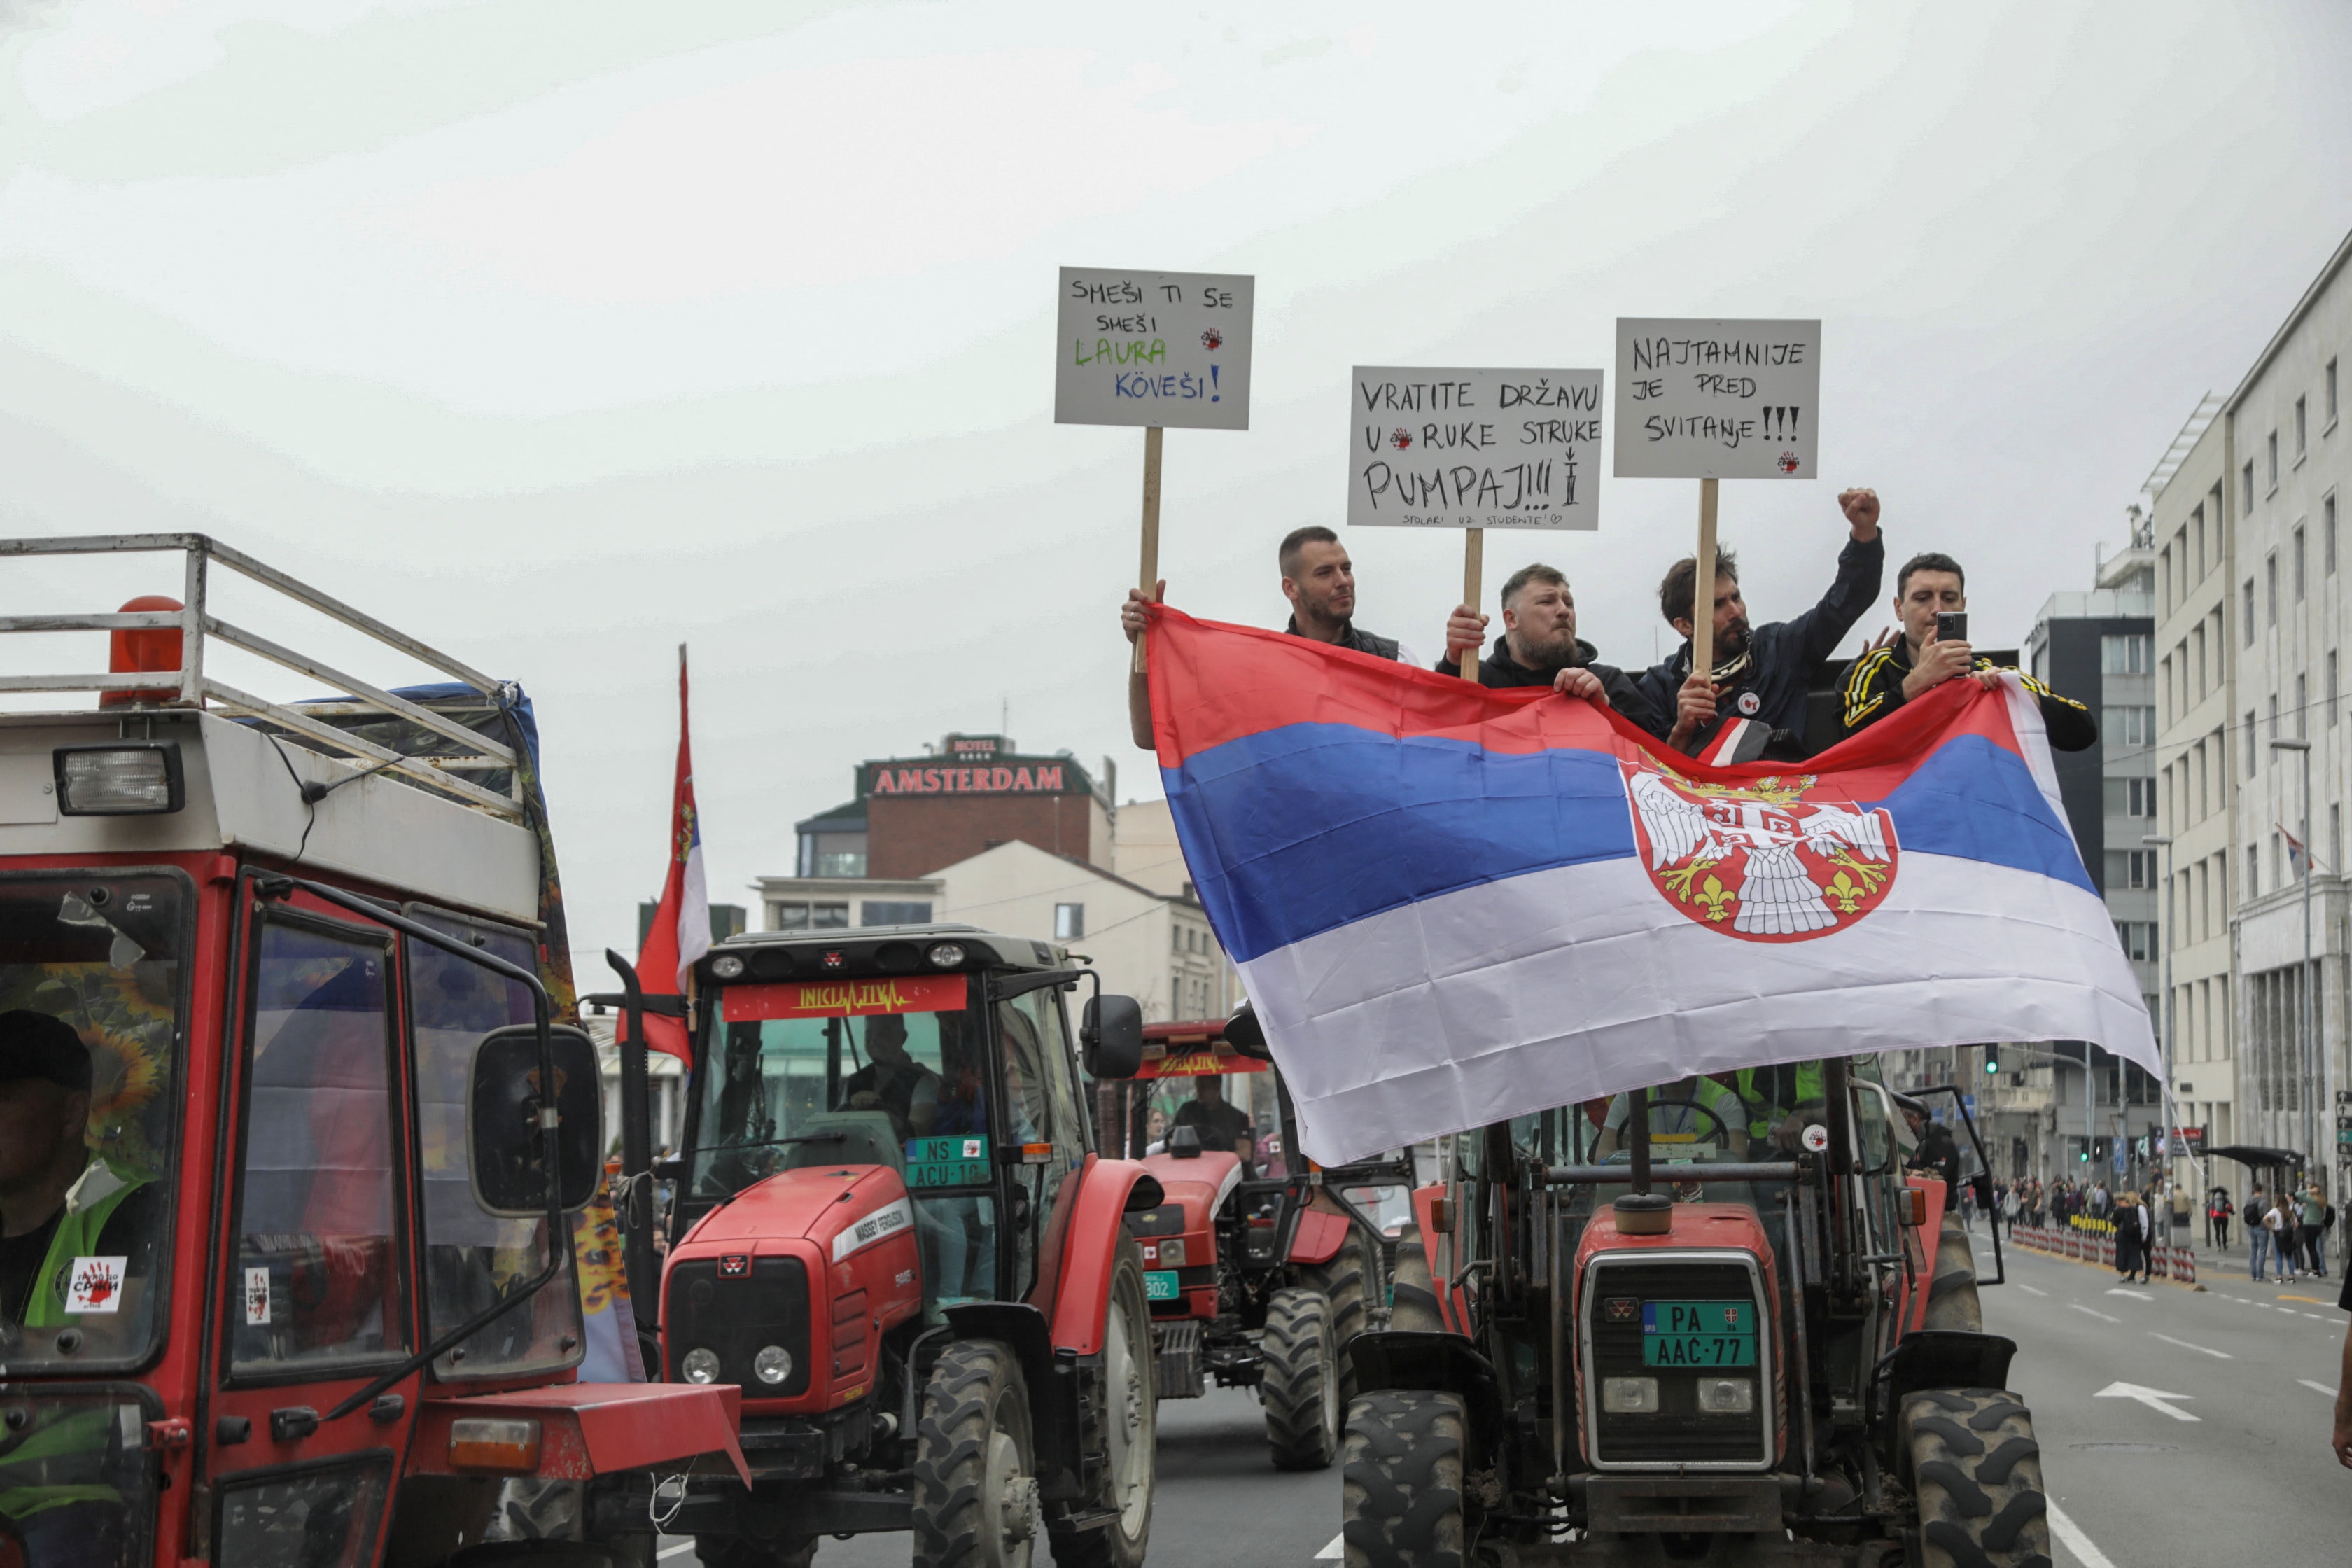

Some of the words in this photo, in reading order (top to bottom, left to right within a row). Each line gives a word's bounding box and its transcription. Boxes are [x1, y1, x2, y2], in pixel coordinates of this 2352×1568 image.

[1071, 280, 1142, 304] SMEŠI
[1159, 285, 1182, 303] TI
[1203, 288, 1233, 309] SE
[1096, 312, 1156, 332] SMEŠI
[1075, 337, 1166, 366] LAURA
[1633, 337, 1806, 372] NAJTAMNIJE
[1361, 382, 1475, 413] VRATITE
[1499, 378, 1599, 412] DRŽAVU
[1631, 379, 1664, 400] JE
[1694, 373, 1757, 398] PRED
[1366, 425, 1380, 452] U
[1422, 421, 1496, 451] RUKE
[1520, 419, 1602, 444] STRUKE
[1403, 515, 1444, 524] STOLARI
[954, 740, 996, 752] HOTEL
[874, 767, 1063, 792] AMSTERDAM
[927, 1141, 948, 1160] NS
[1672, 1306, 1702, 1332] PA
